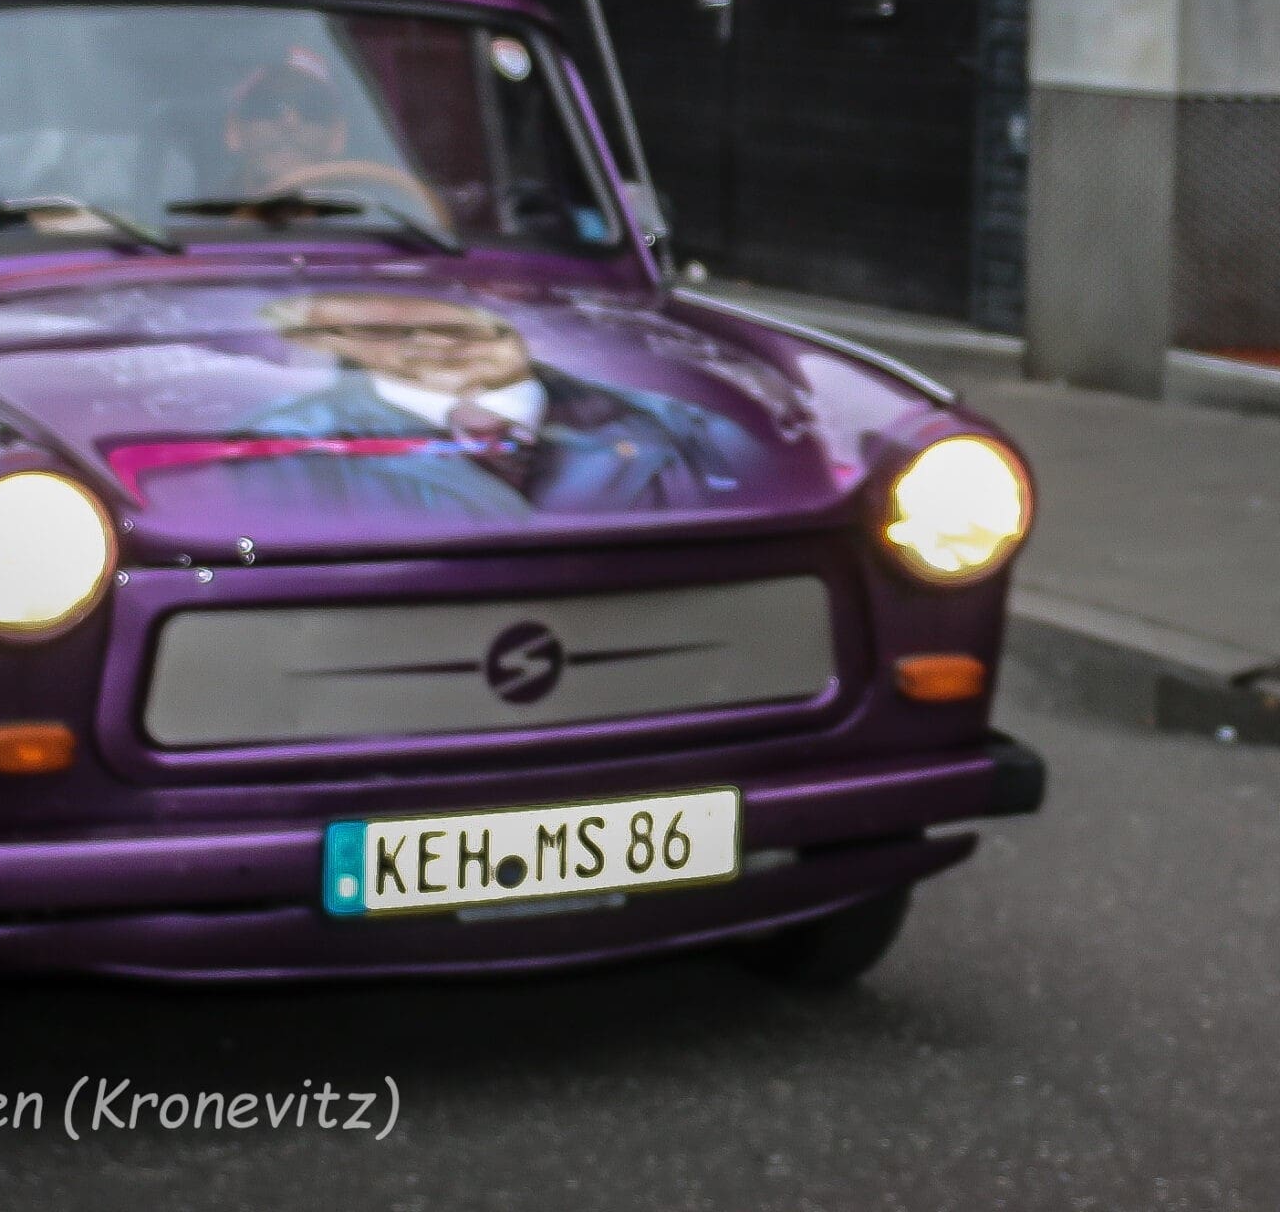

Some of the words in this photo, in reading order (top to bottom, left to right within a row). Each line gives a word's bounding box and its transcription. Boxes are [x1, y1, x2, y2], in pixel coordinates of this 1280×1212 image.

[375, 828, 491, 896] KEH
[535, 816, 606, 882] MS
[625, 810, 692, 875] 86
